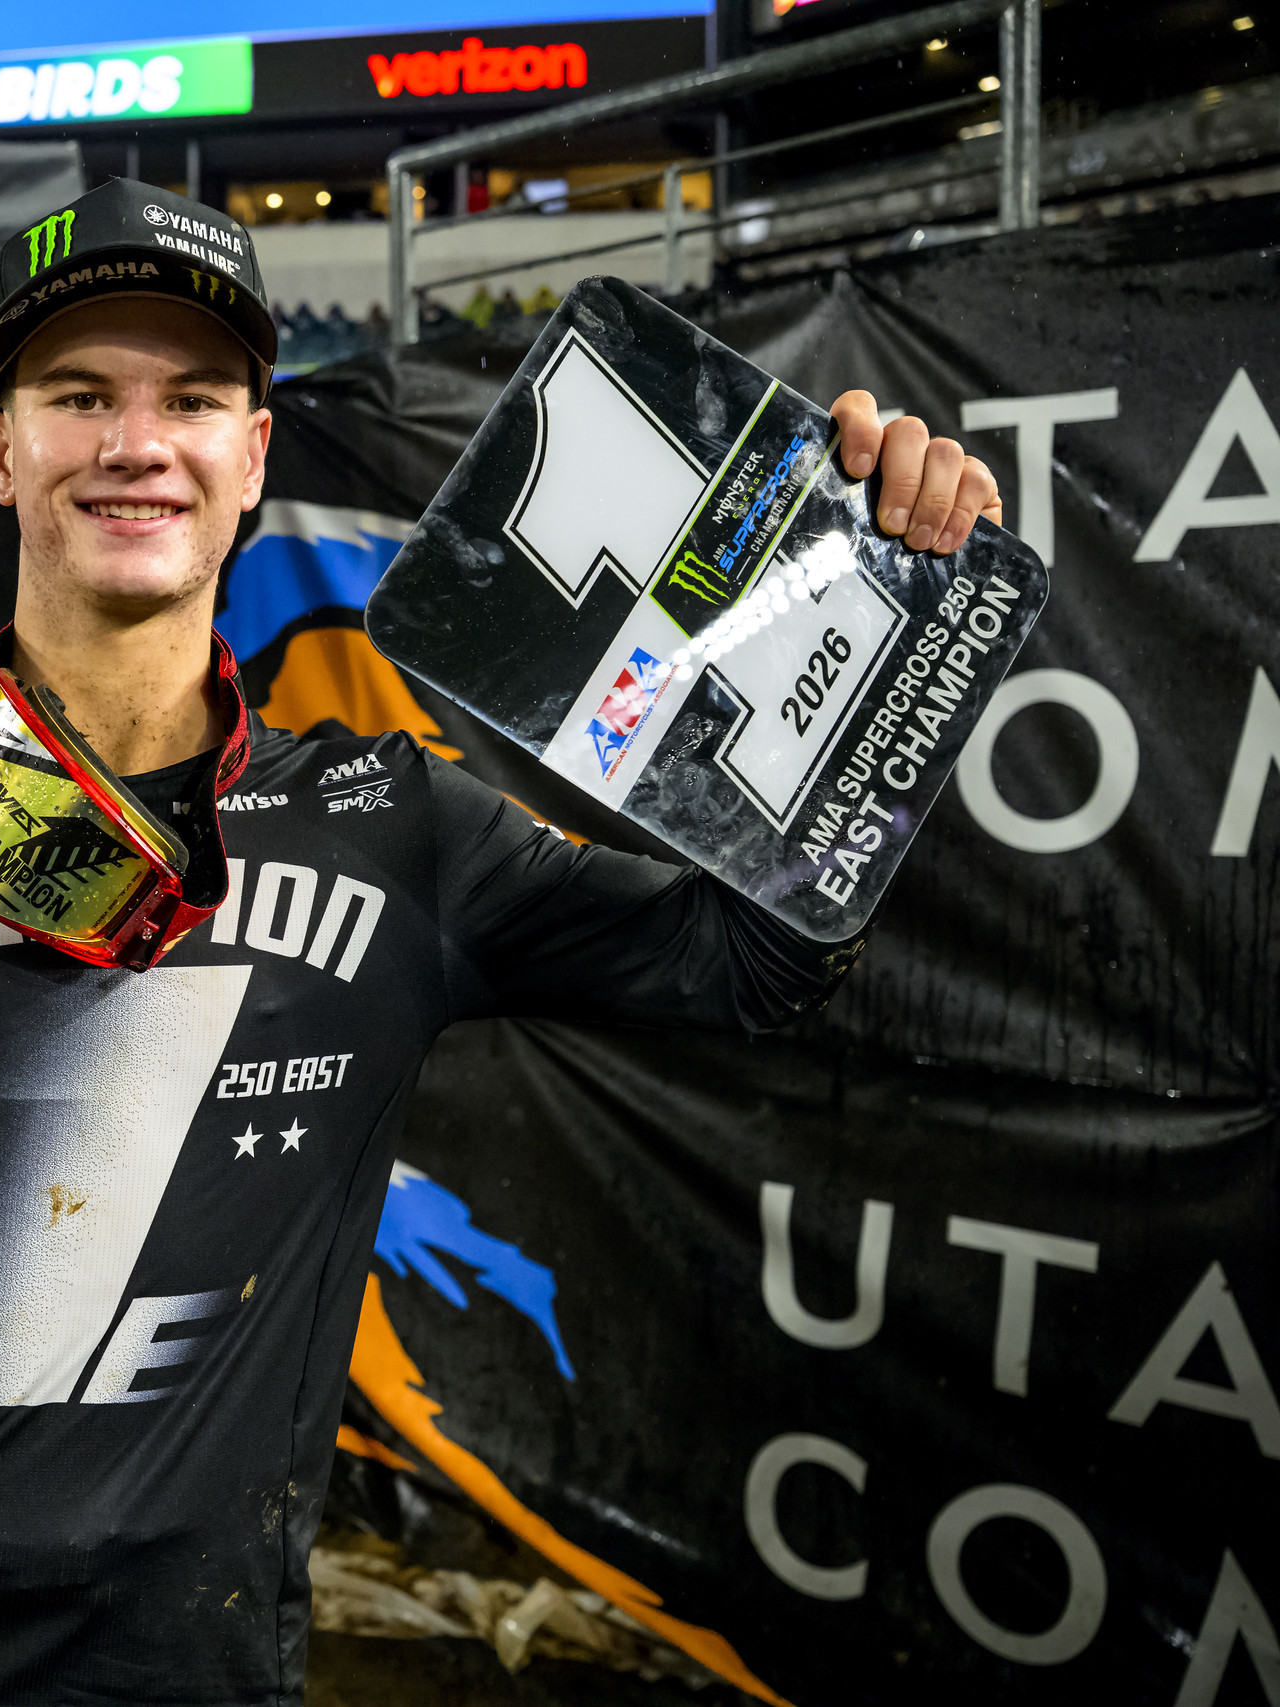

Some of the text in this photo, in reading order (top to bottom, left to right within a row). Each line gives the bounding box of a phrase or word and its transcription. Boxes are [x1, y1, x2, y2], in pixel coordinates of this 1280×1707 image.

[367, 37, 587, 98] verizon
[168, 211, 243, 256] YAMAHA
[30, 261, 160, 301] YAMAHA
[712, 451, 764, 525] MONSTER
[719, 434, 805, 573] SUPERCROSS
[732, 468, 765, 519] ENERGY
[750, 474, 802, 553] CHAMPIONSHIP
[712, 543, 728, 562] AMA
[781, 627, 852, 738] 2026
[605, 749, 628, 783] AMERICAN
[625, 703, 656, 750] MOTORCYCLIST
[801, 576, 976, 866] AMA SUPERCROSS 250
[815, 574, 1021, 906] EAST CHAMPION
[318, 754, 386, 784] AMA
[327, 784, 395, 813] SMX
[217, 1053, 354, 1099] 250 EAST
